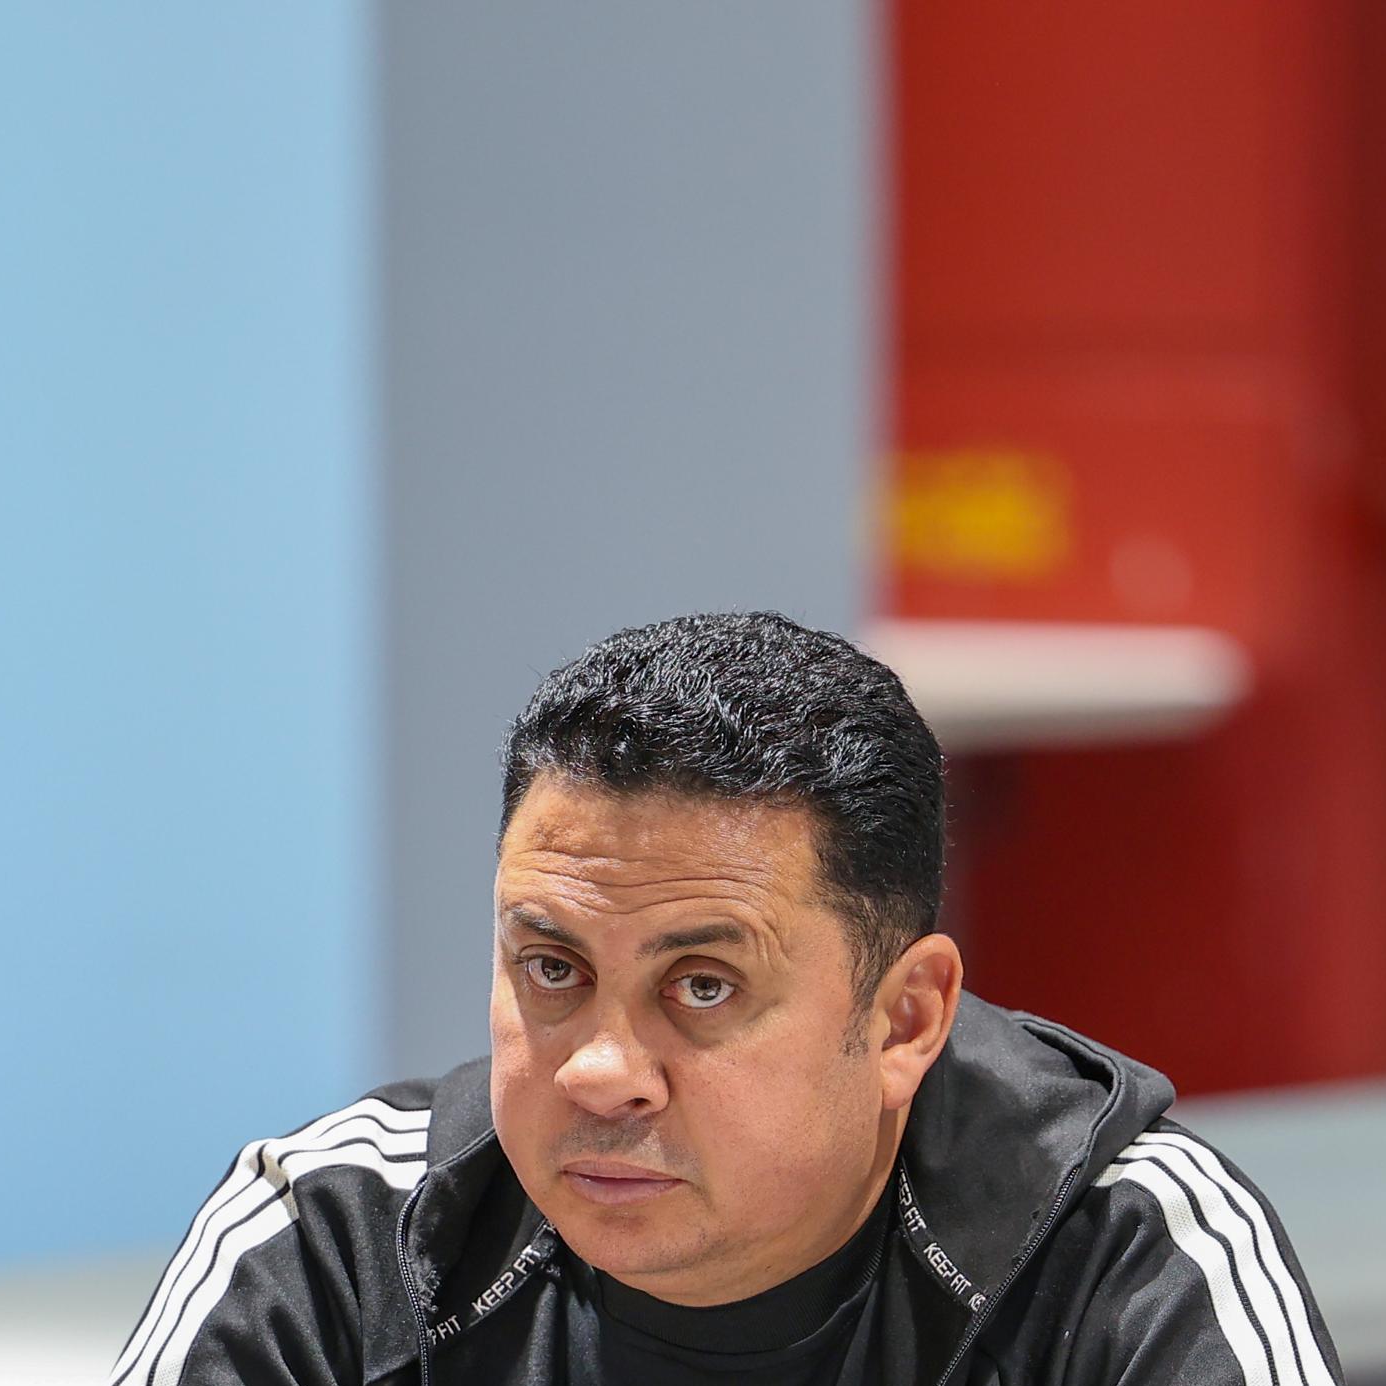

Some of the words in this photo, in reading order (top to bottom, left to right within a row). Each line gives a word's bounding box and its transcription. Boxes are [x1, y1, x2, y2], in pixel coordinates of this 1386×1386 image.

[436, 1314, 461, 1340] FIT
[471, 1271, 515, 1316] KEEP
[513, 1244, 542, 1275] FIT
[904, 1206, 927, 1232] FIT
[923, 1242, 958, 1279] KEEP
[950, 1274, 972, 1295] FIT
